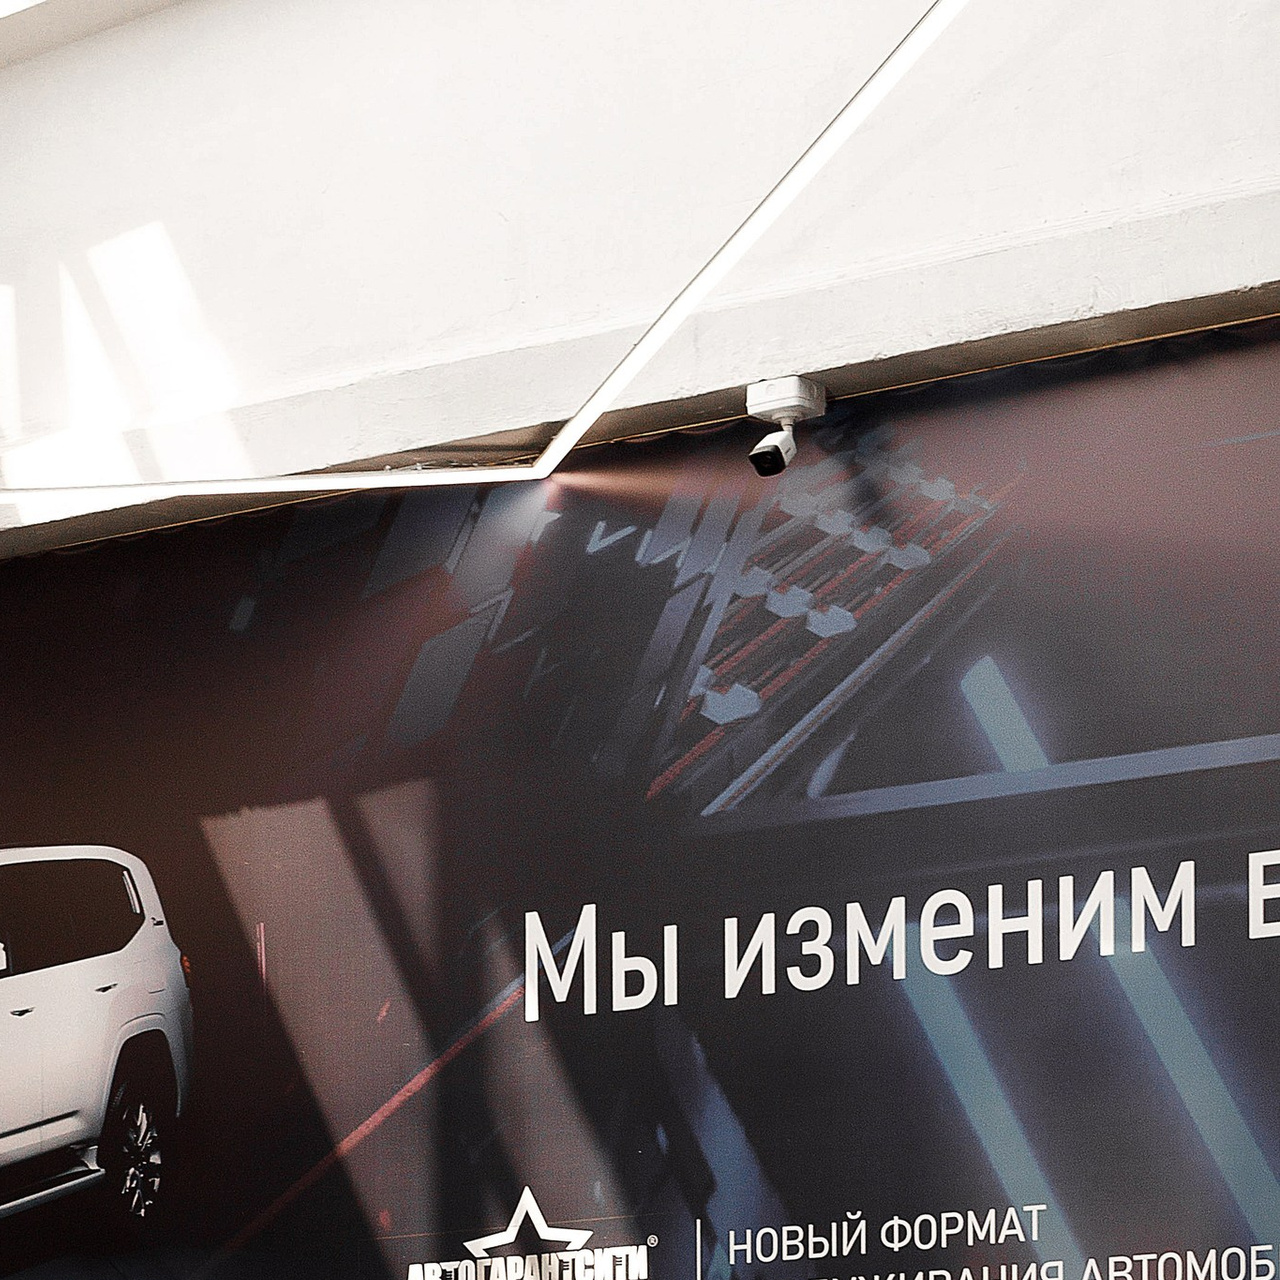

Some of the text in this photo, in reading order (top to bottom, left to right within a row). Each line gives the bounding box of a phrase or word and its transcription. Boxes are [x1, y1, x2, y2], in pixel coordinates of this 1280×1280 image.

[524, 904, 679, 1022] Мы
[724, 860, 1196, 999] изменим
[728, 1204, 1048, 1265] НОВЫЙ ФОРМАТ
